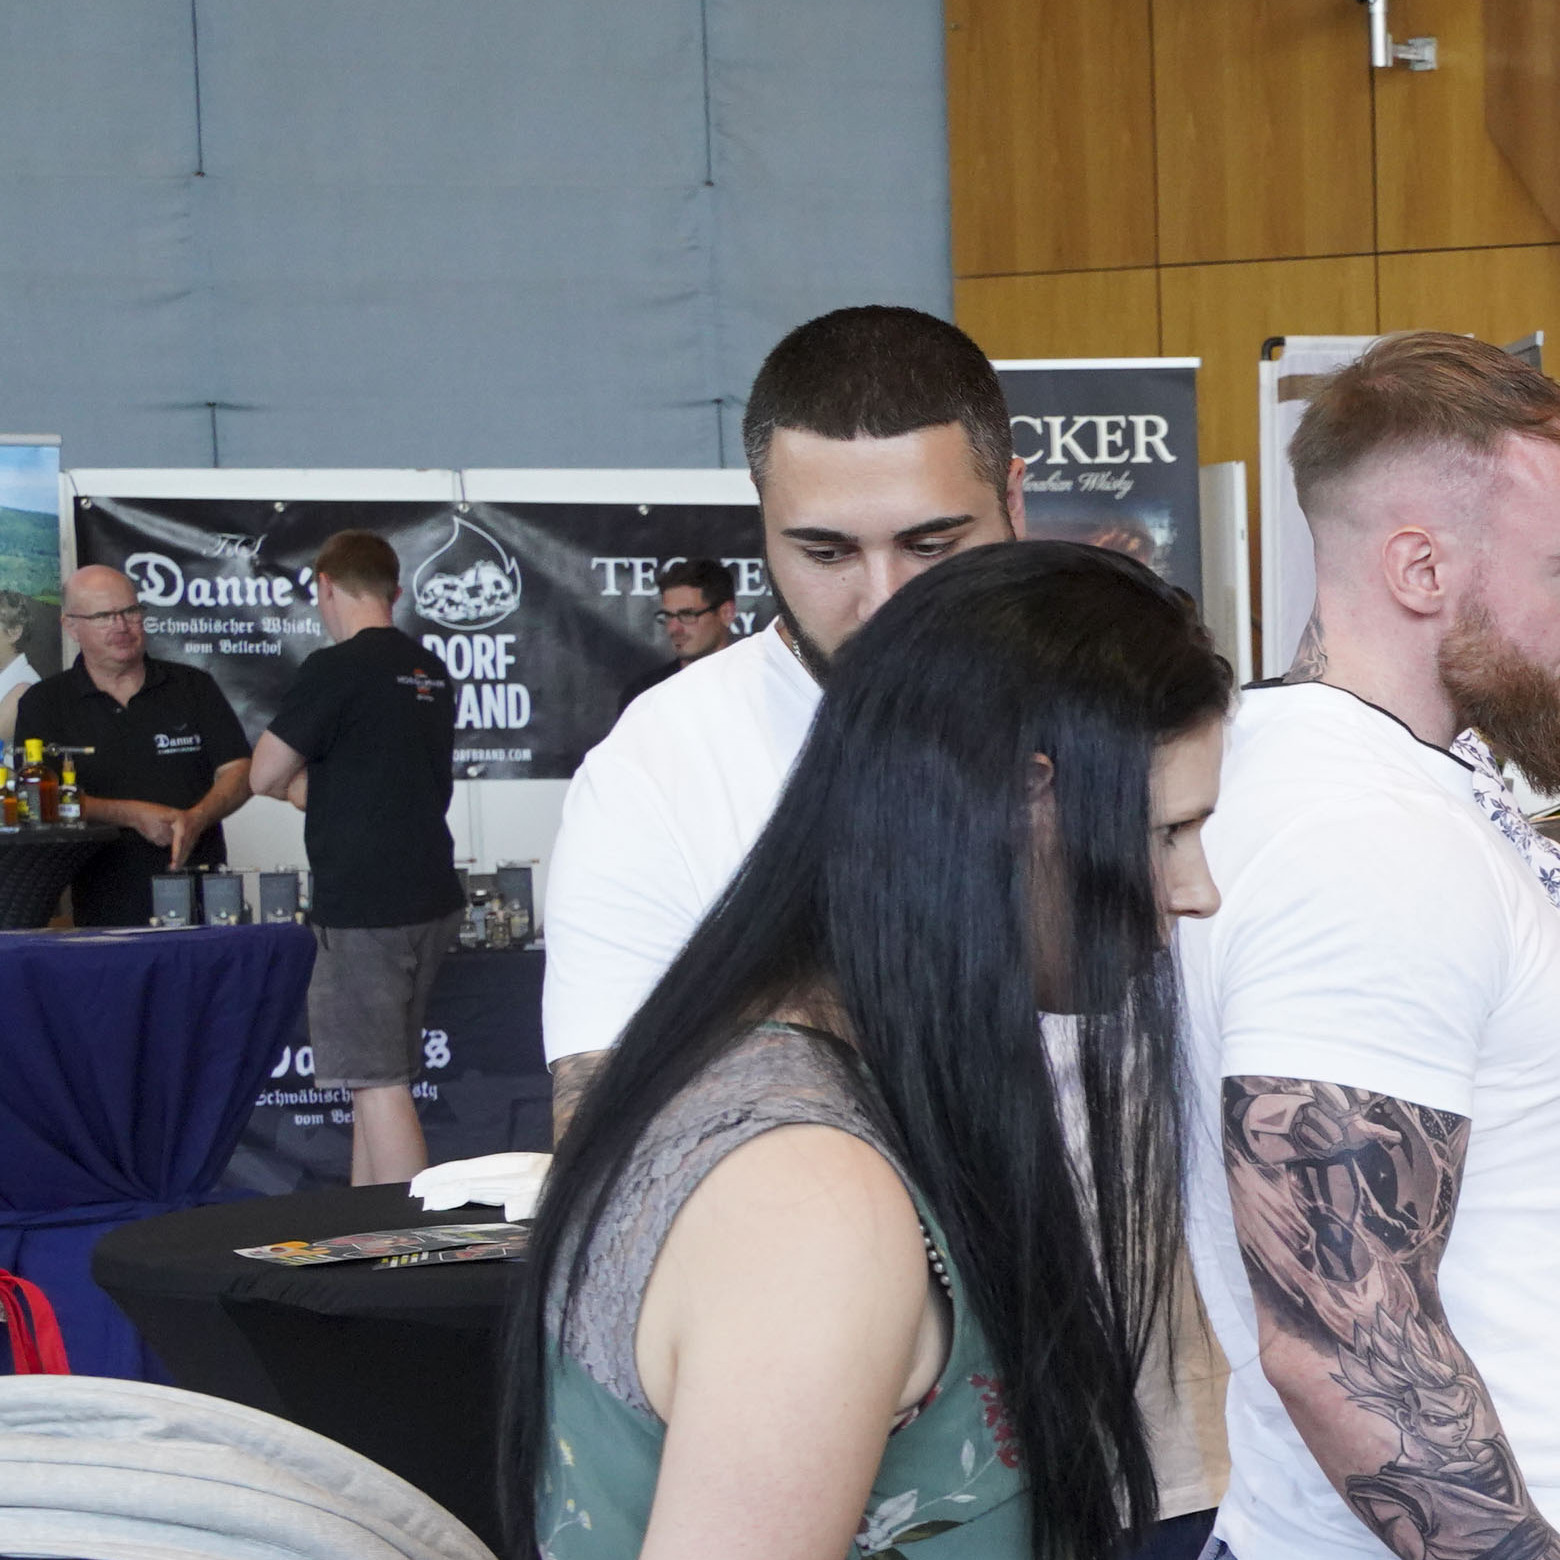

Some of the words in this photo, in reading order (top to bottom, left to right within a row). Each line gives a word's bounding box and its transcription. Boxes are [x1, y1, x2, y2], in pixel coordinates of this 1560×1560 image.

[1009, 415, 1178, 464] CKER
[455, 683, 531, 729] AND
[452, 748, 532, 761] ORFBRAND.COM
